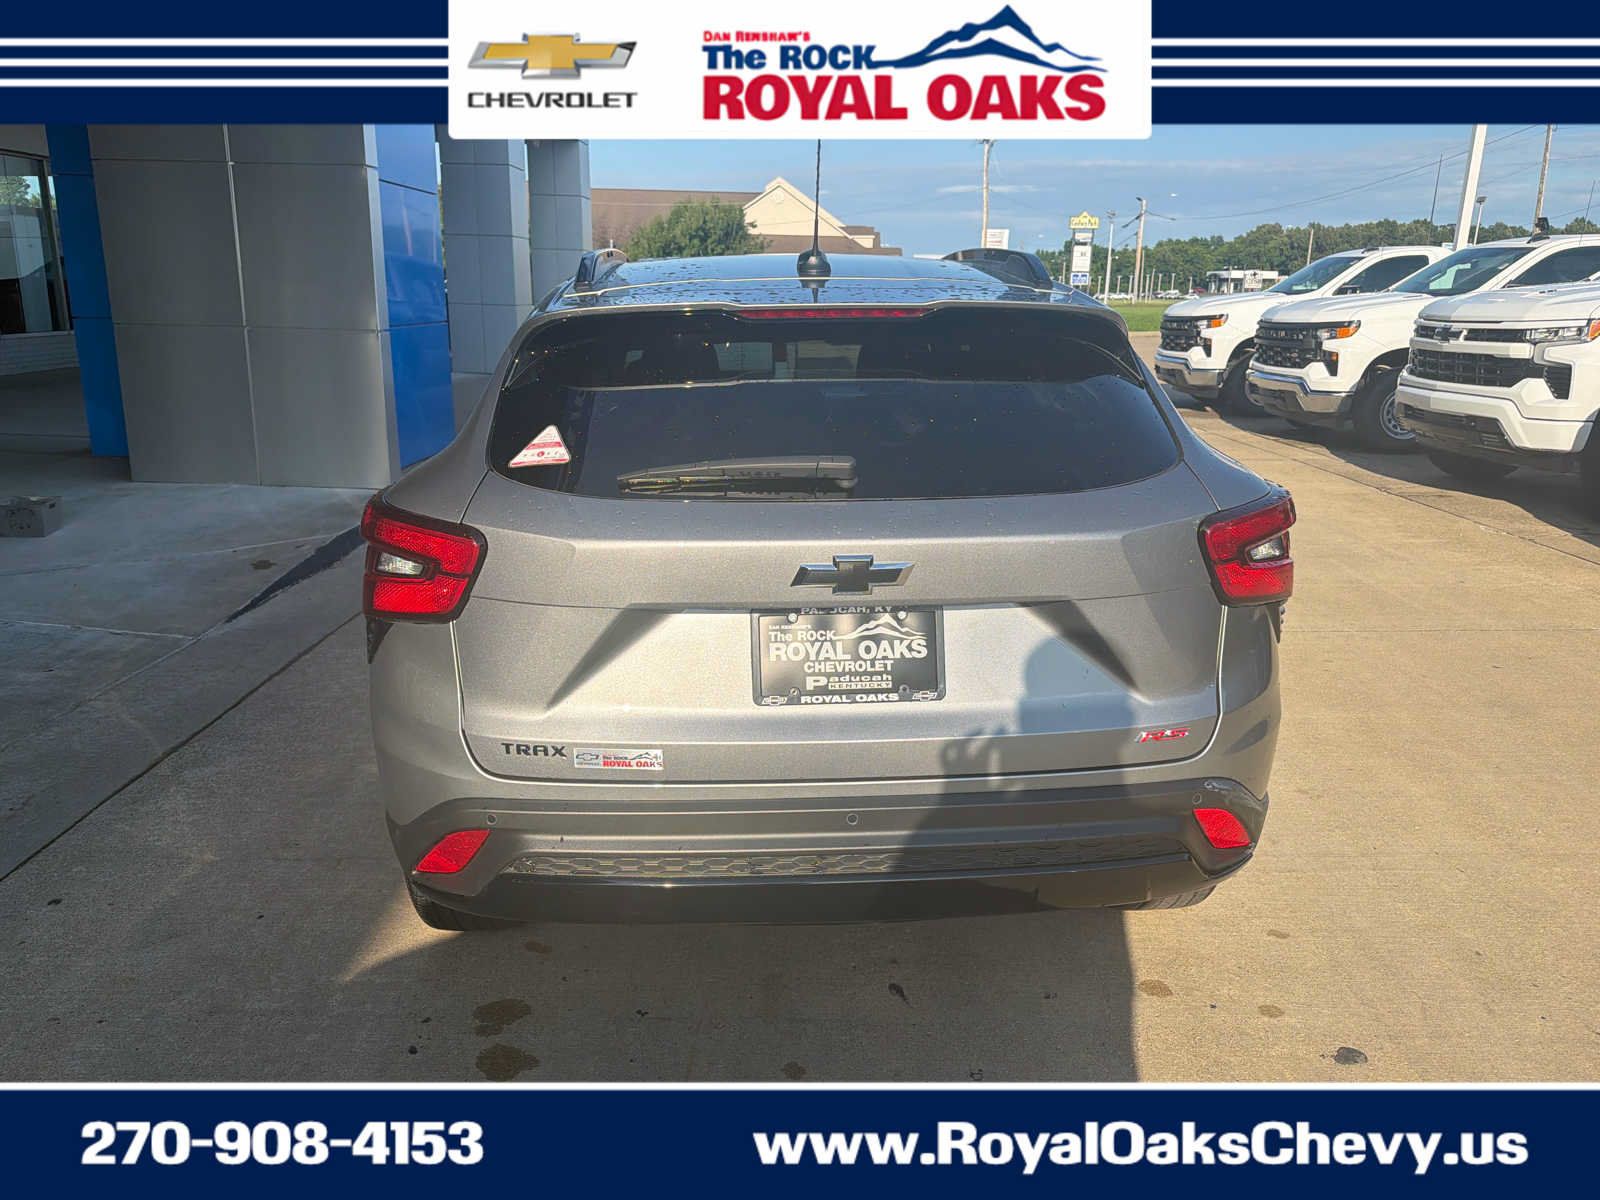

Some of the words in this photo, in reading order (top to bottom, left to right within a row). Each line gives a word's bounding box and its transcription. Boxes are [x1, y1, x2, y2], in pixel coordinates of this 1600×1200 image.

[768, 630, 793, 642] The
[797, 630, 836, 641] ROCK
[768, 641, 850, 662] ROYAL
[858, 639, 928, 660] OAKS
[803, 660, 894, 673] CHEVROLET
[806, 674, 892, 691] Paducah
[830, 682, 892, 690] KENTUCKY
[800, 693, 851, 704] ROYAL
[855, 692, 899, 703] OAKS
[1135, 727, 1190, 744] RS
[501, 742, 567, 758] TRAX
[602, 760, 633, 768] ROYAL
[635, 760, 663, 768] OAKS
